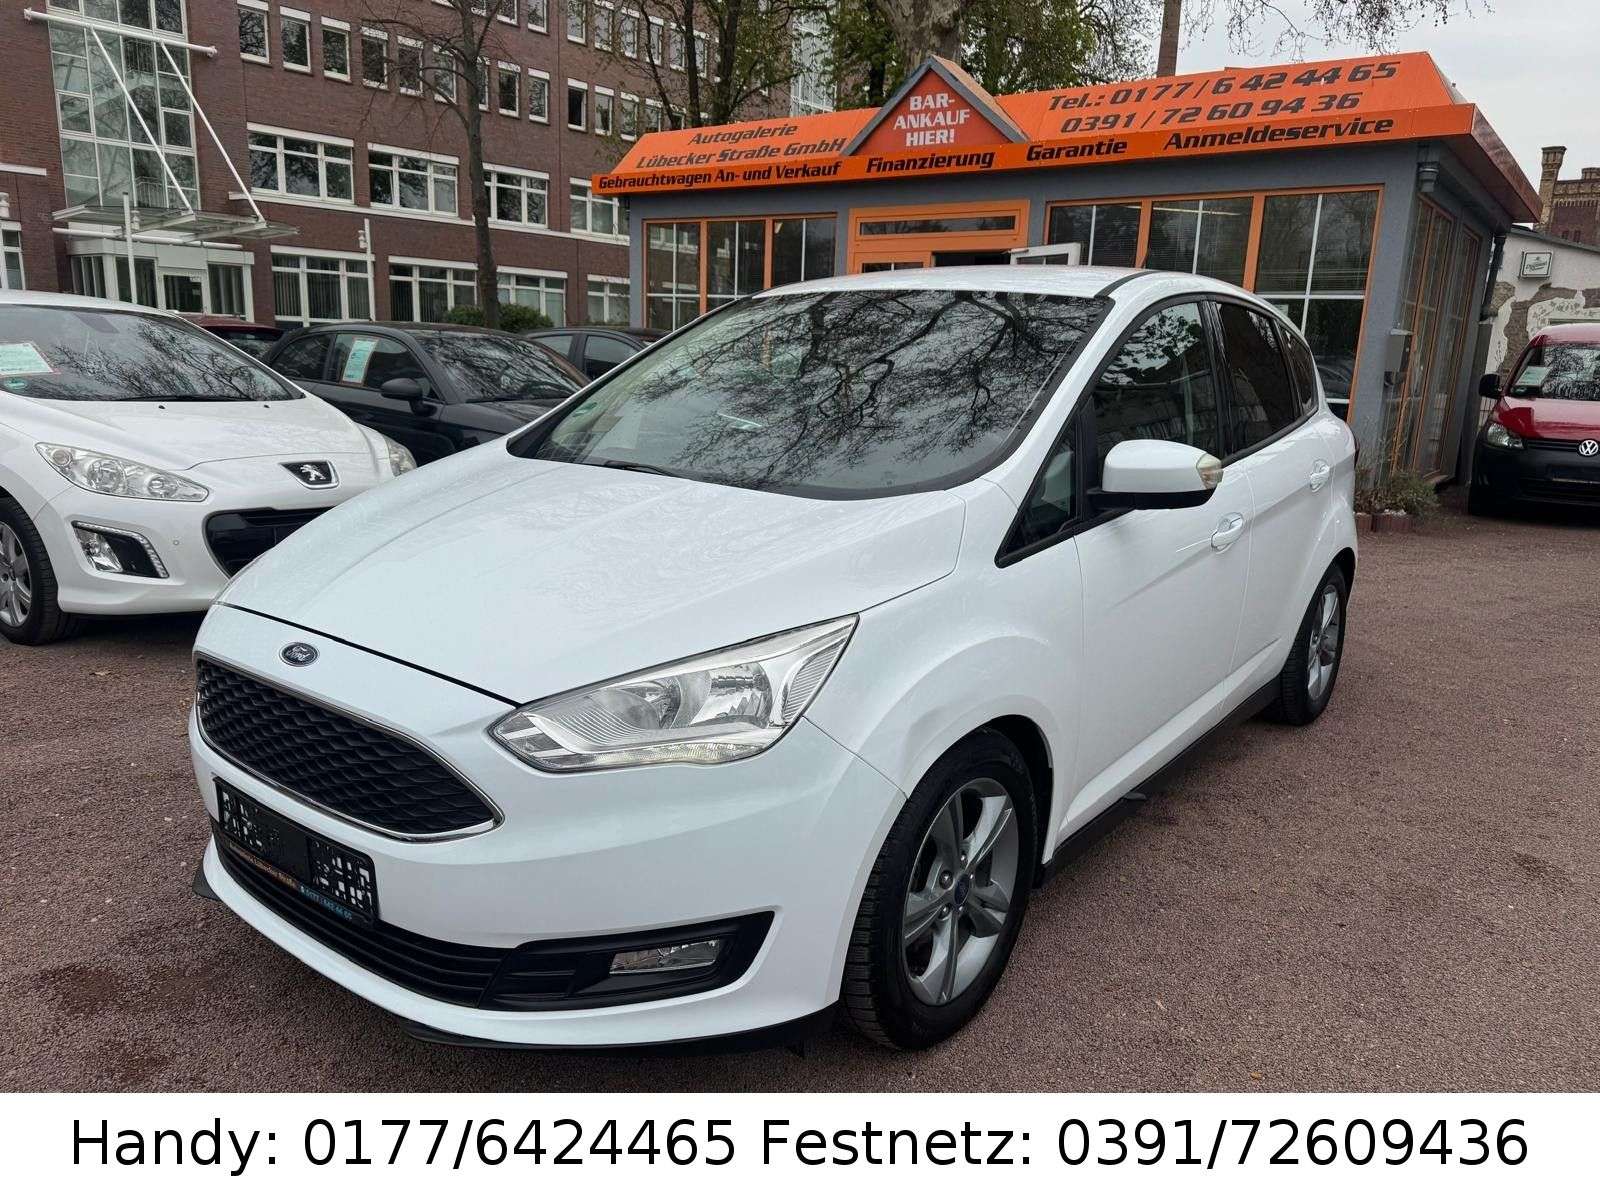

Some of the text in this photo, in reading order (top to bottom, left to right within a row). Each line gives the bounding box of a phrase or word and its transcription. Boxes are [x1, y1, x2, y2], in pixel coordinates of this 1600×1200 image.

[1048, 93, 1106, 111] Tel.:
[1109, 81, 1194, 105] 0177
[1212, 77, 1237, 96] 6
[1240, 72, 1288, 92] 42
[1292, 66, 1343, 87] 44
[1347, 61, 1401, 83] 65
[909, 93, 956, 112] BAR-
[1060, 112, 1137, 134] 0391
[1159, 106, 1203, 125] 72
[1206, 101, 1254, 121] 60
[1256, 96, 1307, 117] 94
[1311, 91, 1364, 112] 36
[892, 109, 971, 131] ANKAUF
[687, 123, 798, 146] Autogalerie
[905, 128, 955, 147] HIER!
[1163, 117, 1394, 151] Anmeldeservice
[636, 137, 847, 169] Lübecker Straße GmbH
[1026, 138, 1128, 162] Garantie
[866, 151, 996, 174] Finanzierung
[598, 161, 844, 190] Gebrauchtwagen An- und Verkauf
